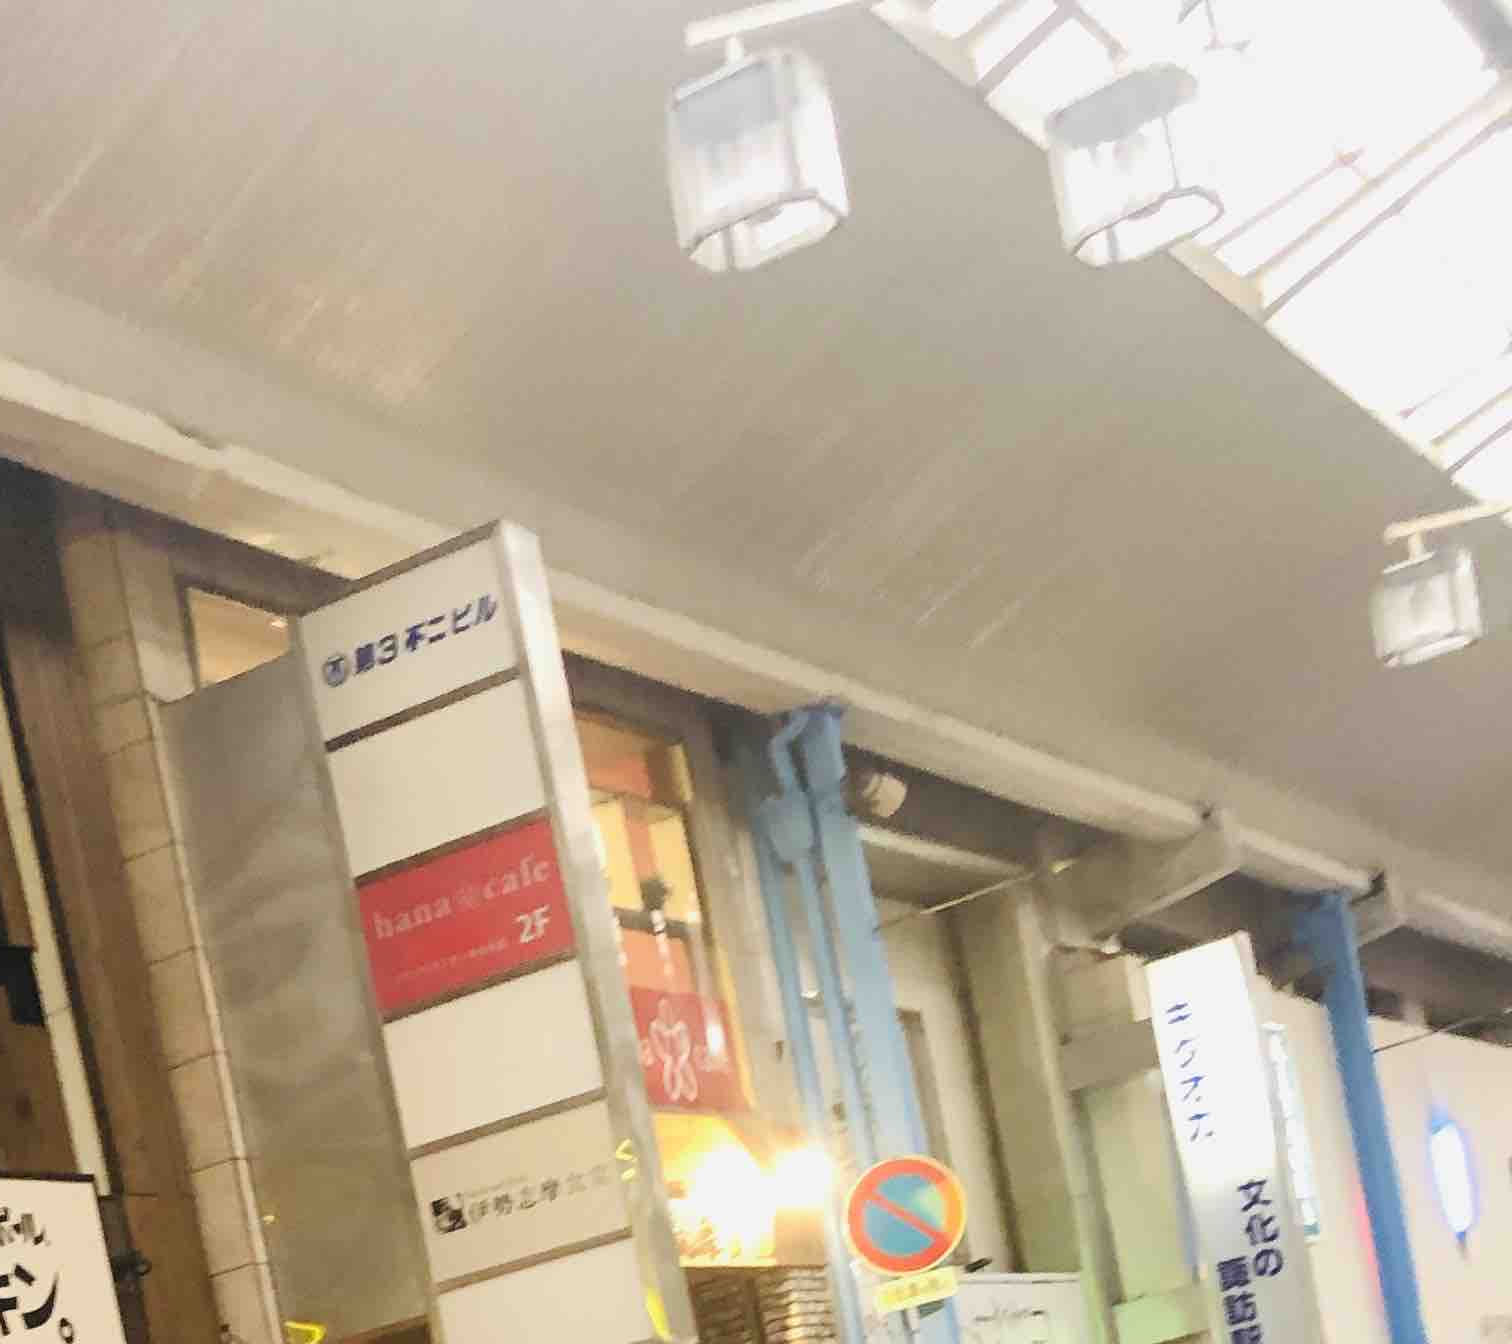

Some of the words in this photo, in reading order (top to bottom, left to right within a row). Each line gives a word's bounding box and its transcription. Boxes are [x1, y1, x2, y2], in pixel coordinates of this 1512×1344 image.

[372, 897, 453, 939] hana
[482, 853, 551, 899] cafe
[514, 903, 551, 944] 2F
